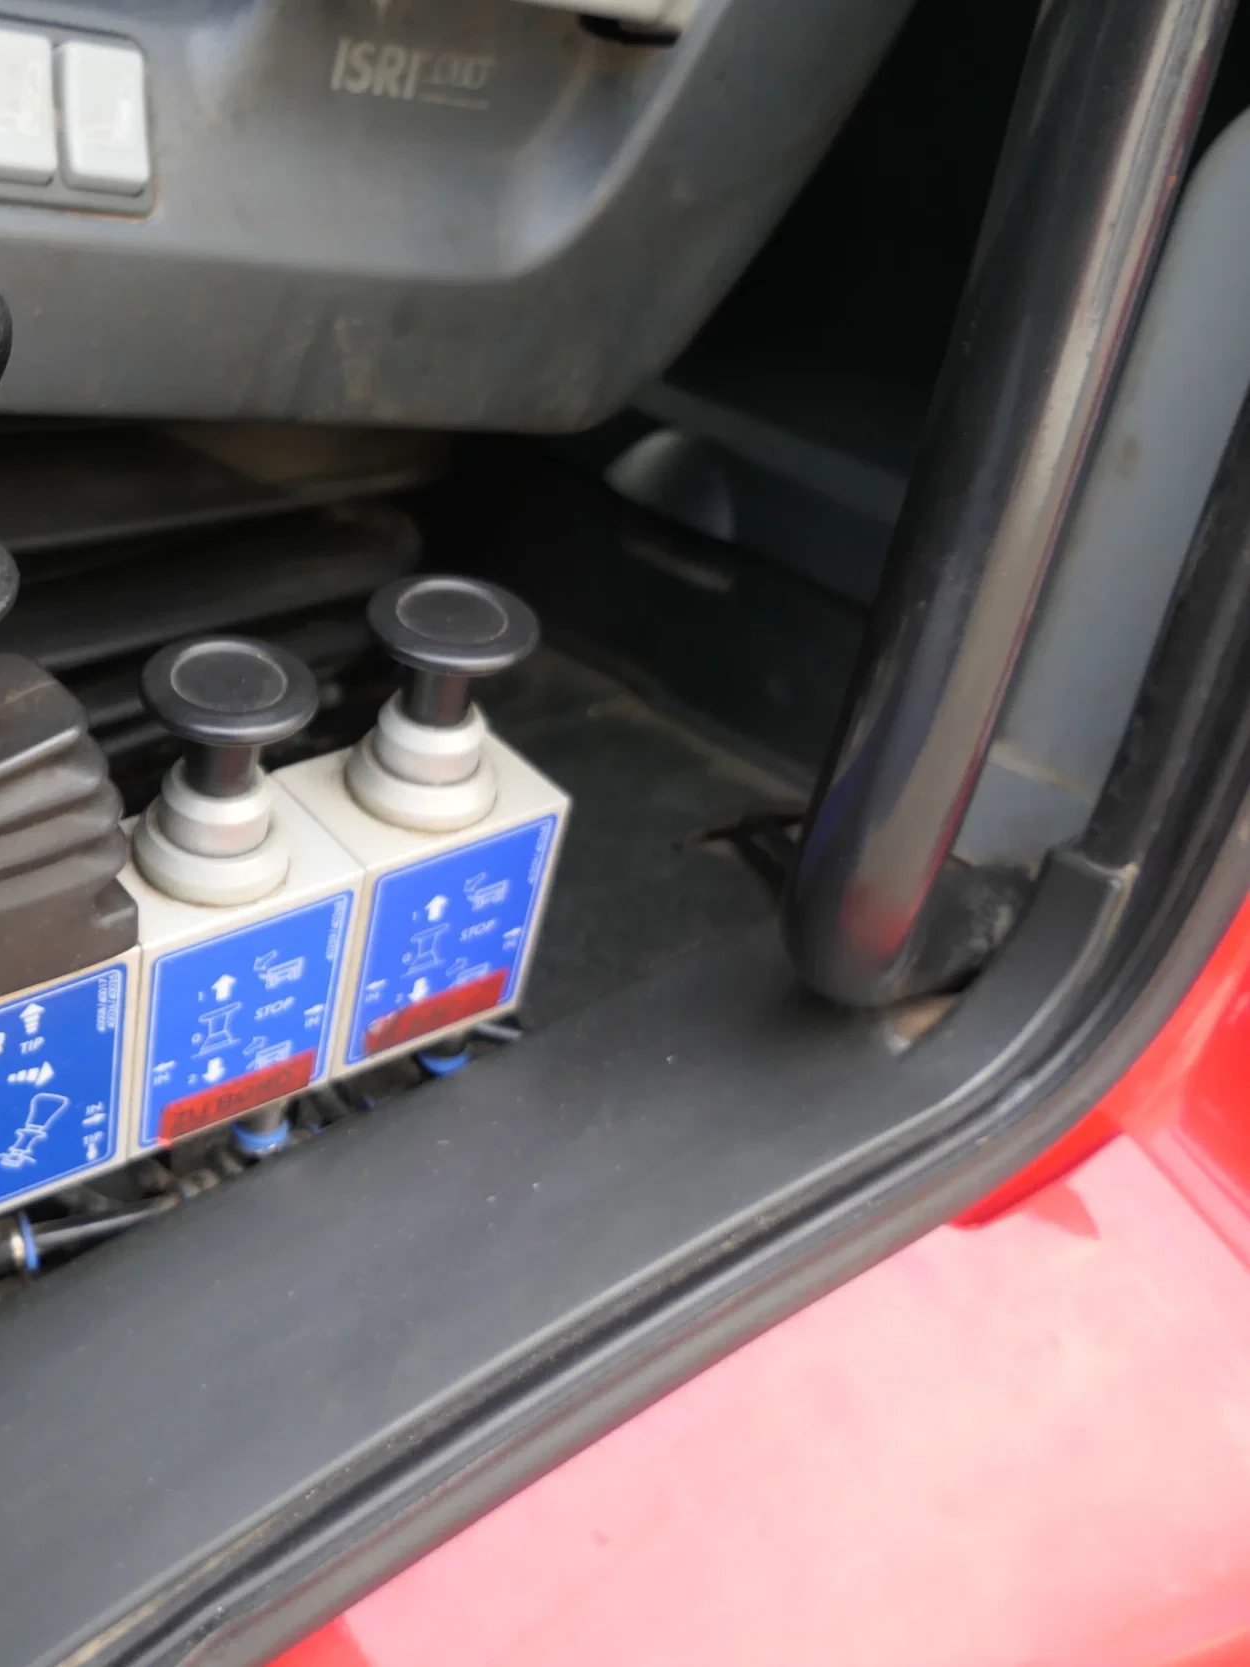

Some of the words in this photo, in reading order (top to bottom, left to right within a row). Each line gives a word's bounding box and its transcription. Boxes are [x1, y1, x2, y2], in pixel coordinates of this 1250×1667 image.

[332, 38, 424, 99] ISRI
[460, 918, 496, 941] STOP
[254, 996, 295, 1020] STOP
[19, 1035, 46, 1055] TIP
